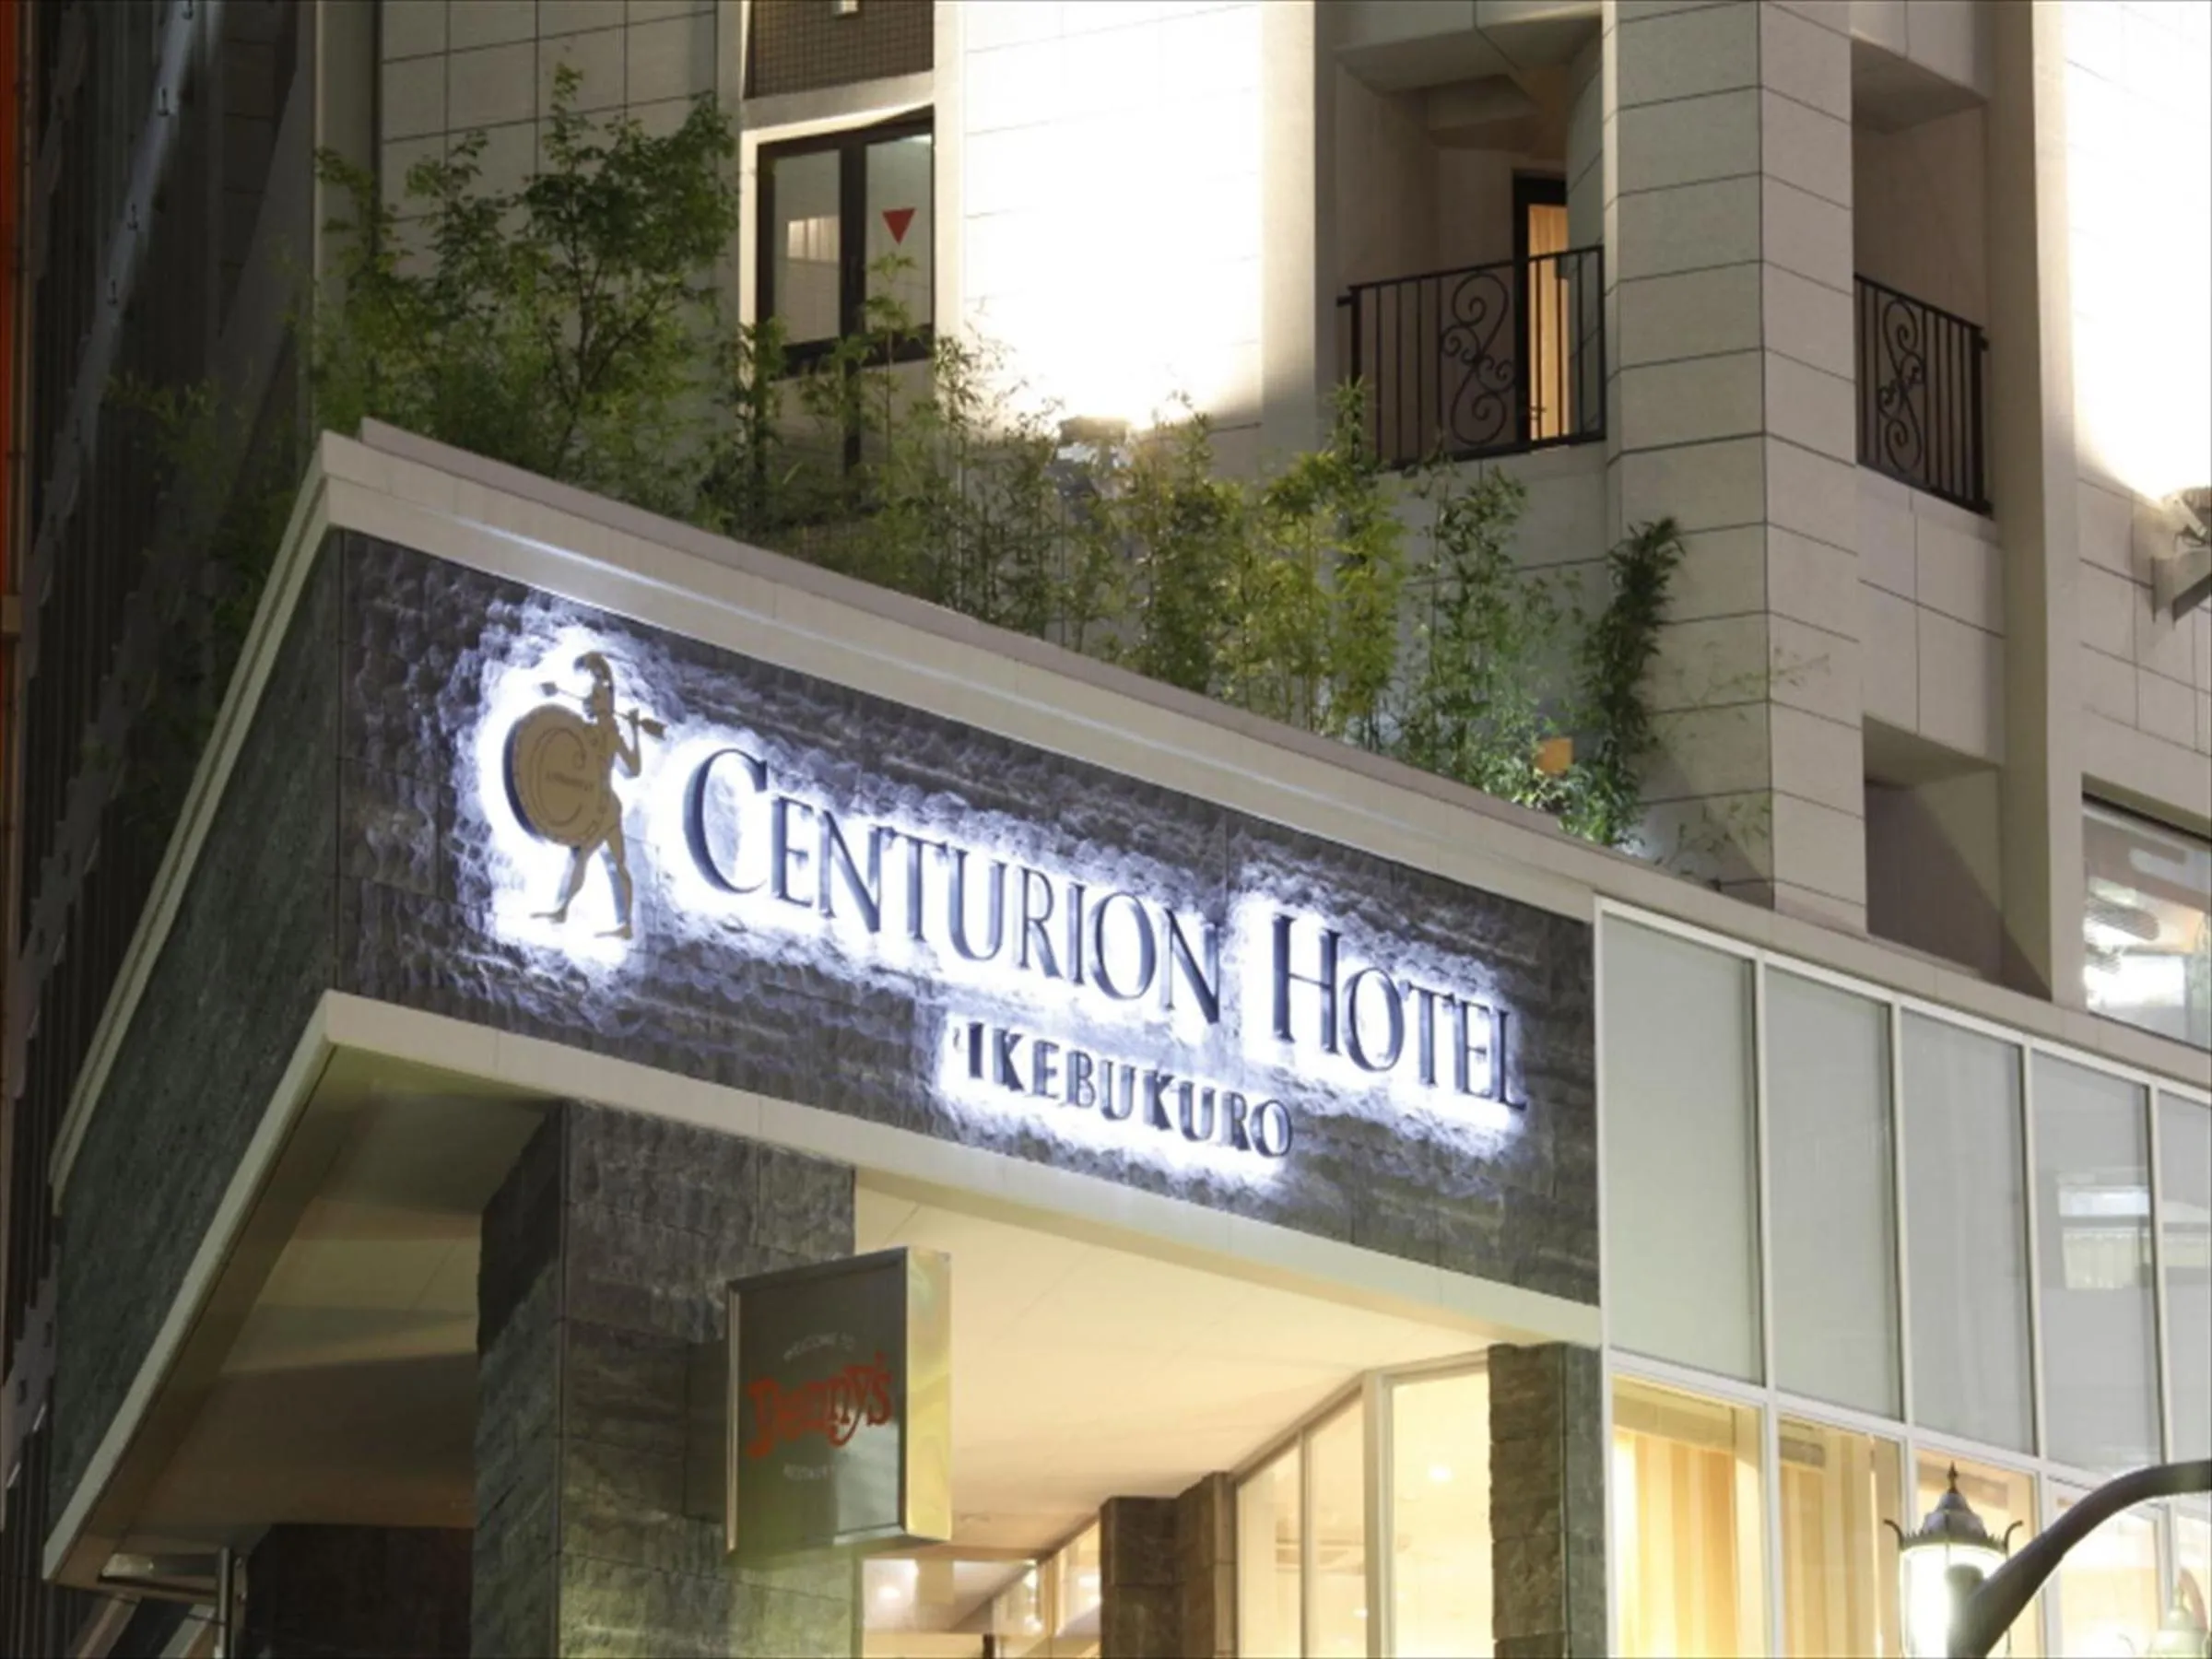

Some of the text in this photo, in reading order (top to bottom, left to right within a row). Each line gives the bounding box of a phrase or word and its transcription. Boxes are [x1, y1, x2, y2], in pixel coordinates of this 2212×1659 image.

[683, 748, 1525, 1112] CENTURION HOTEL
[968, 1021, 1293, 1159] IKEBUKURO
